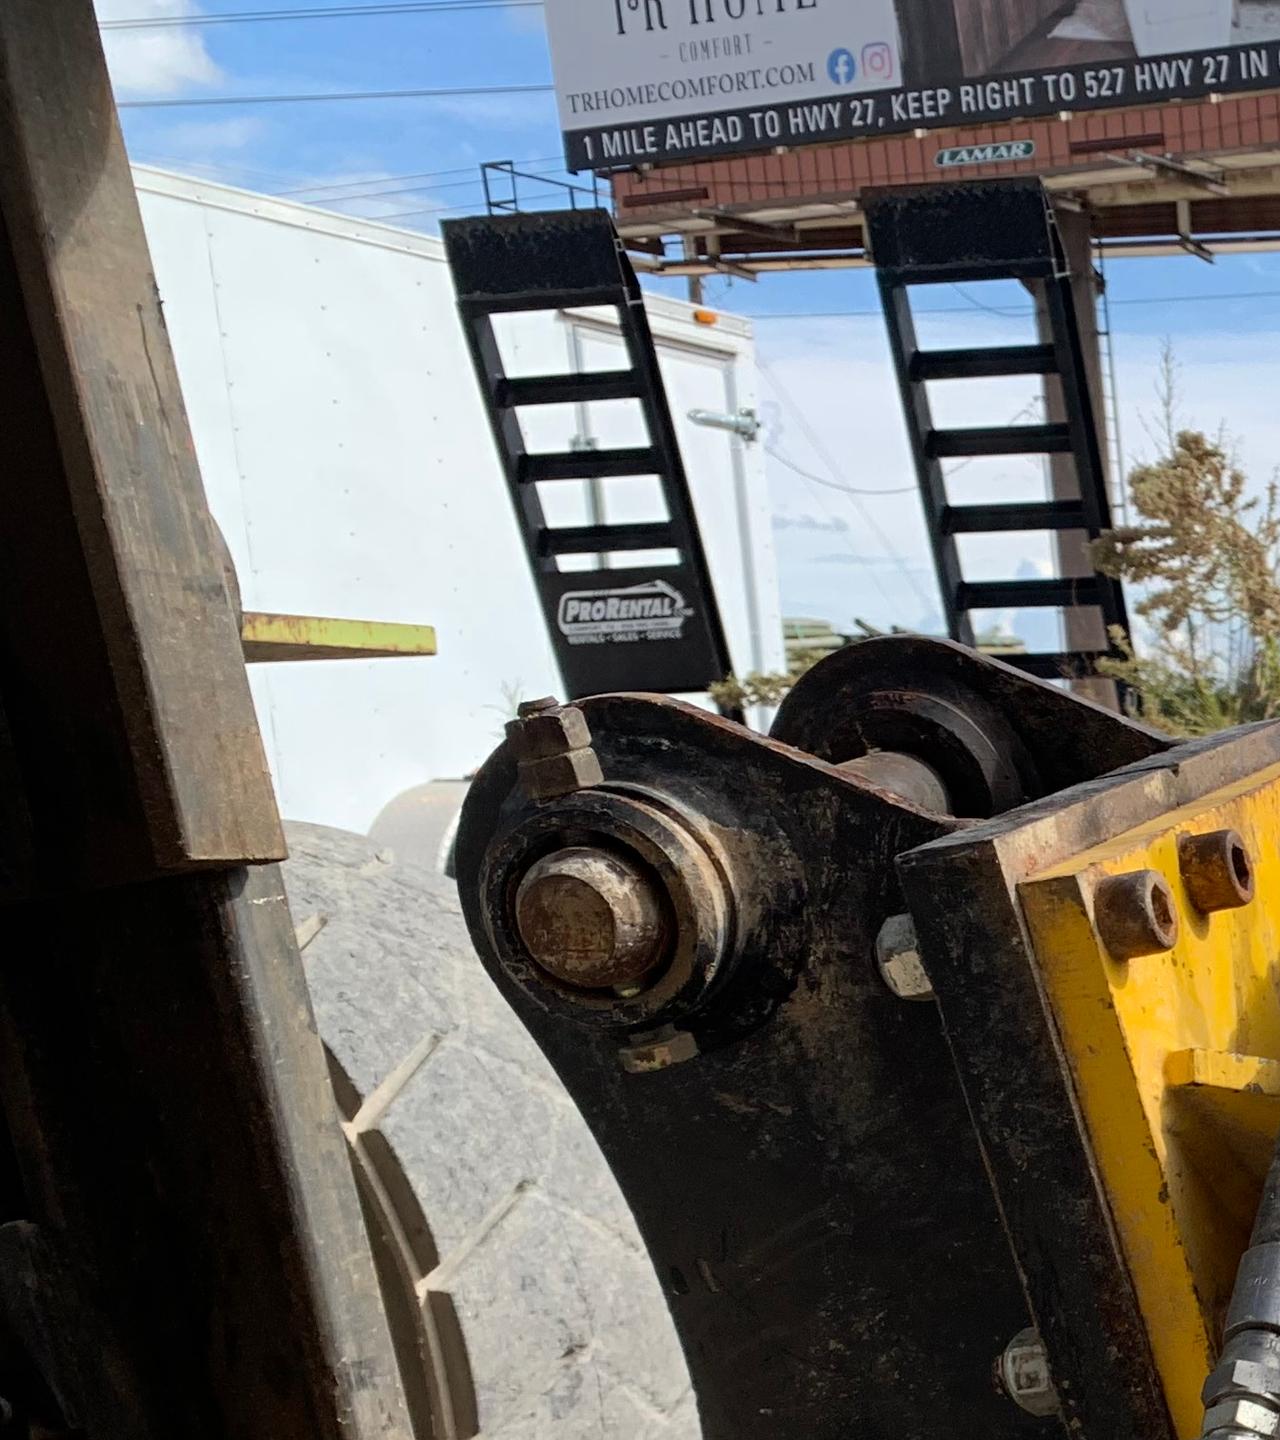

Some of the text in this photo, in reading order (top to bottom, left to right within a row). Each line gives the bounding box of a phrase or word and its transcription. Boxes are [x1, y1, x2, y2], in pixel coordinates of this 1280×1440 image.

[679, 33, 753, 63] COMFORT
[566, 62, 817, 114] TRHOMECOMFORT.COM
[583, 135, 594, 160] 1
[601, 127, 657, 158] MILE
[665, 115, 743, 150] AHEAD
[749, 111, 781, 140] TO
[789, 101, 842, 134] HWY
[850, 98, 885, 128] 27,
[891, 88, 951, 122] KEEP
[960, 77, 1035, 114] RIGHT
[1042, 72, 1075, 103] TO
[1084, 67, 1124, 99] 527
[1135, 58, 1193, 92] HWY
[1202, 55, 1230, 84] 27
[1240, 50, 1269, 79] IN
[942, 142, 1026, 166] LAMAR
